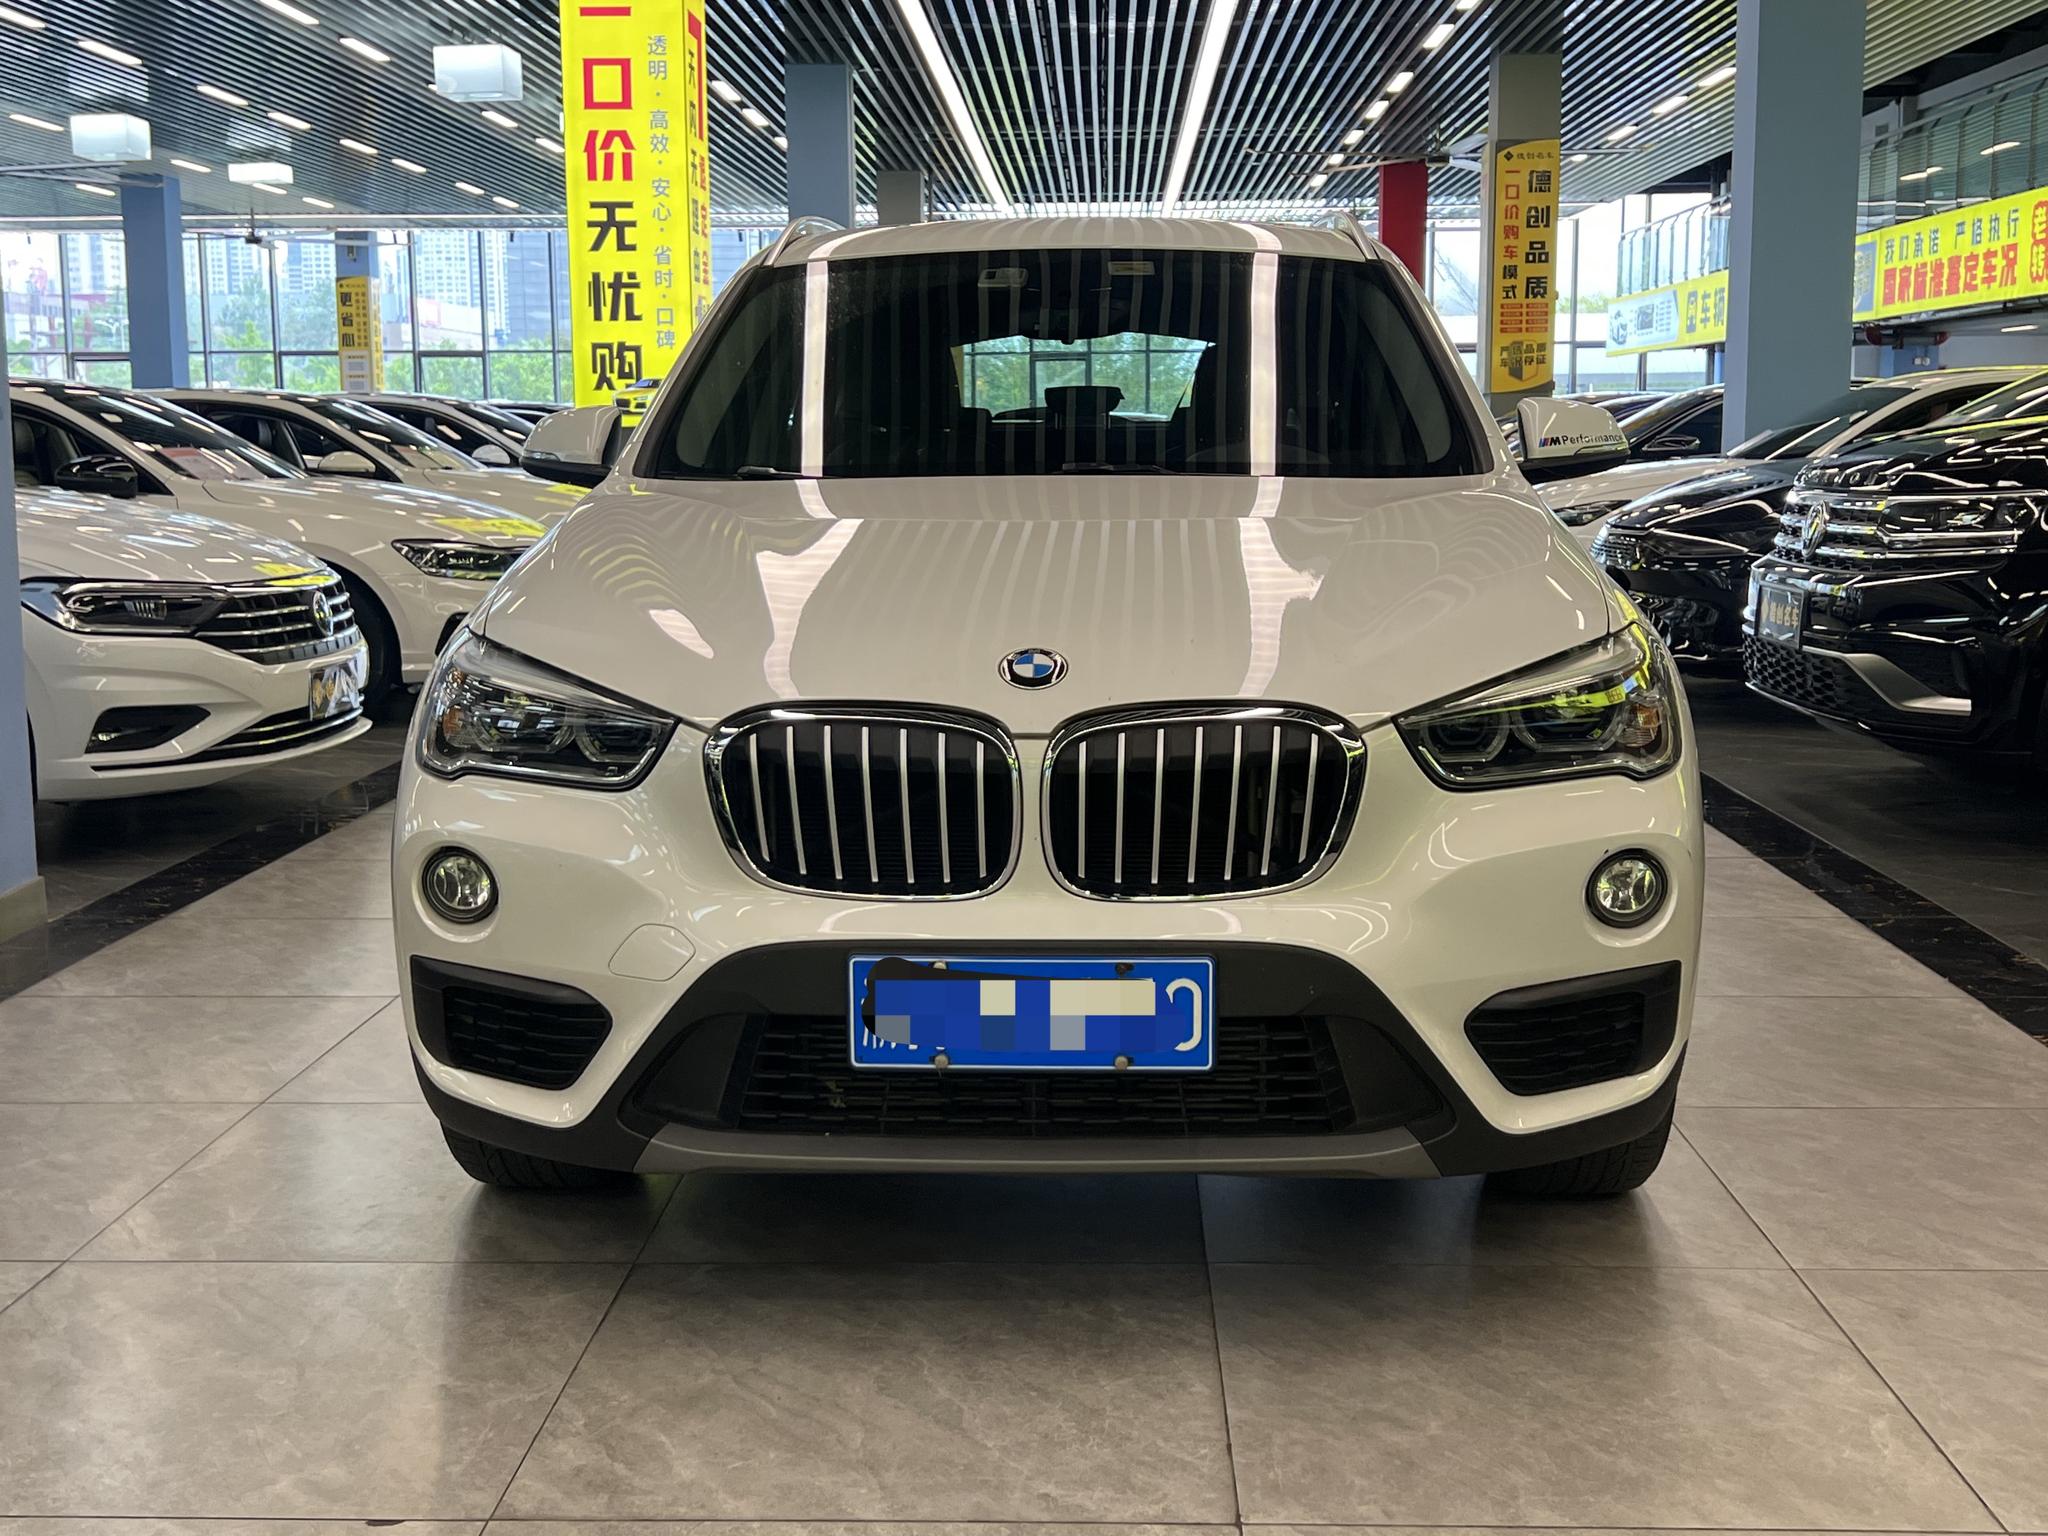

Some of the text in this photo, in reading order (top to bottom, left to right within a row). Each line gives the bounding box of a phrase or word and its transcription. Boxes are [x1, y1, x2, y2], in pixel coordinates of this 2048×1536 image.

[579, 6, 643, 391] 一口价无忧购
[1502, 170, 1521, 299] 一口价购车模式
[1525, 169, 1552, 299] 德创品质
[1882, 242, 2019, 307] 国家标准鉴定车况
